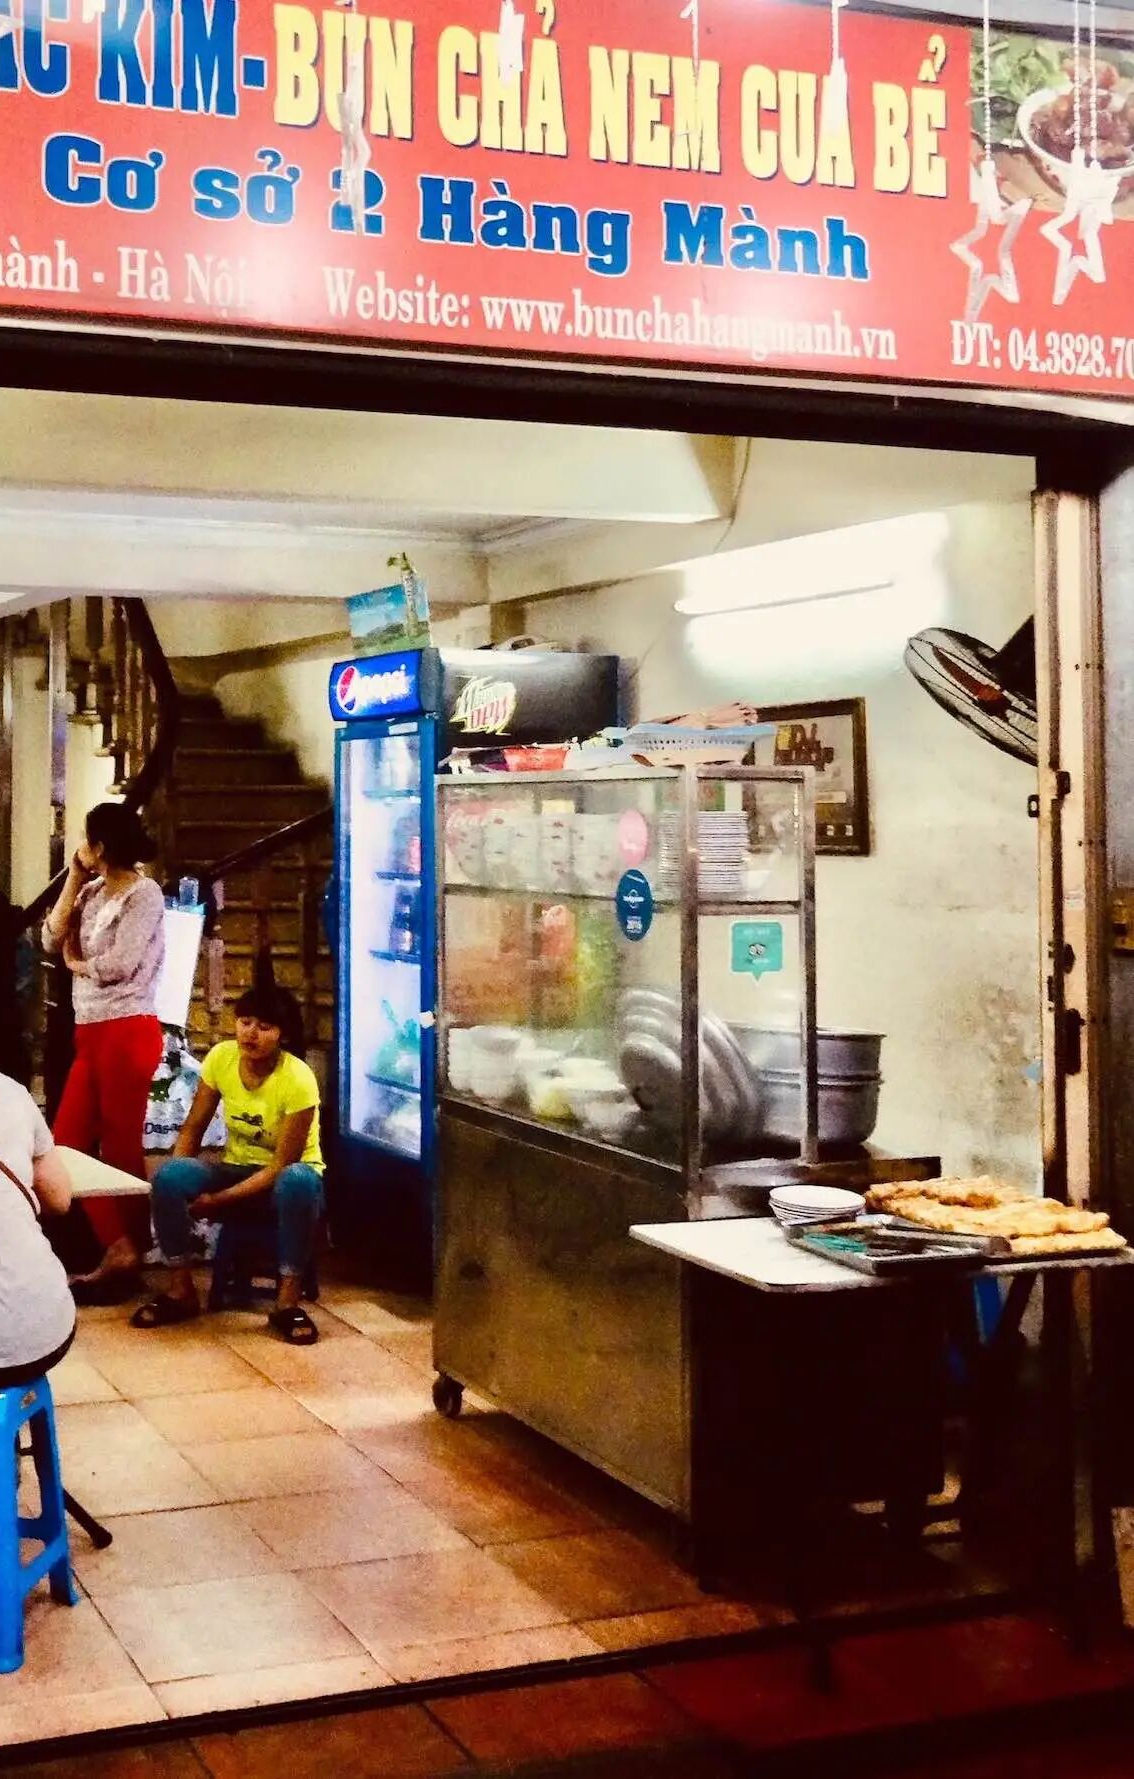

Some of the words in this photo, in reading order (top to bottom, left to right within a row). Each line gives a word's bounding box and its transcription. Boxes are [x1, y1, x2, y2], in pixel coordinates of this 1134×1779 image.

[588, 46, 722, 174] NEM
[740, 56, 857, 189] CUA
[871, 34, 948, 198] BỂ
[42, 131, 166, 213] Cơ
[192, 148, 302, 229] sở
[330, 167, 386, 236] 2
[418, 174, 632, 277] Hàng
[661, 200, 870, 280] Mành
[117, 247, 171, 303] Hà
[184, 252, 248, 318] Nội
[322, 265, 471, 329] Website:
[479, 288, 898, 361] www.bunchahangmanh.vn
[950, 320, 1002, 369] ĐT:
